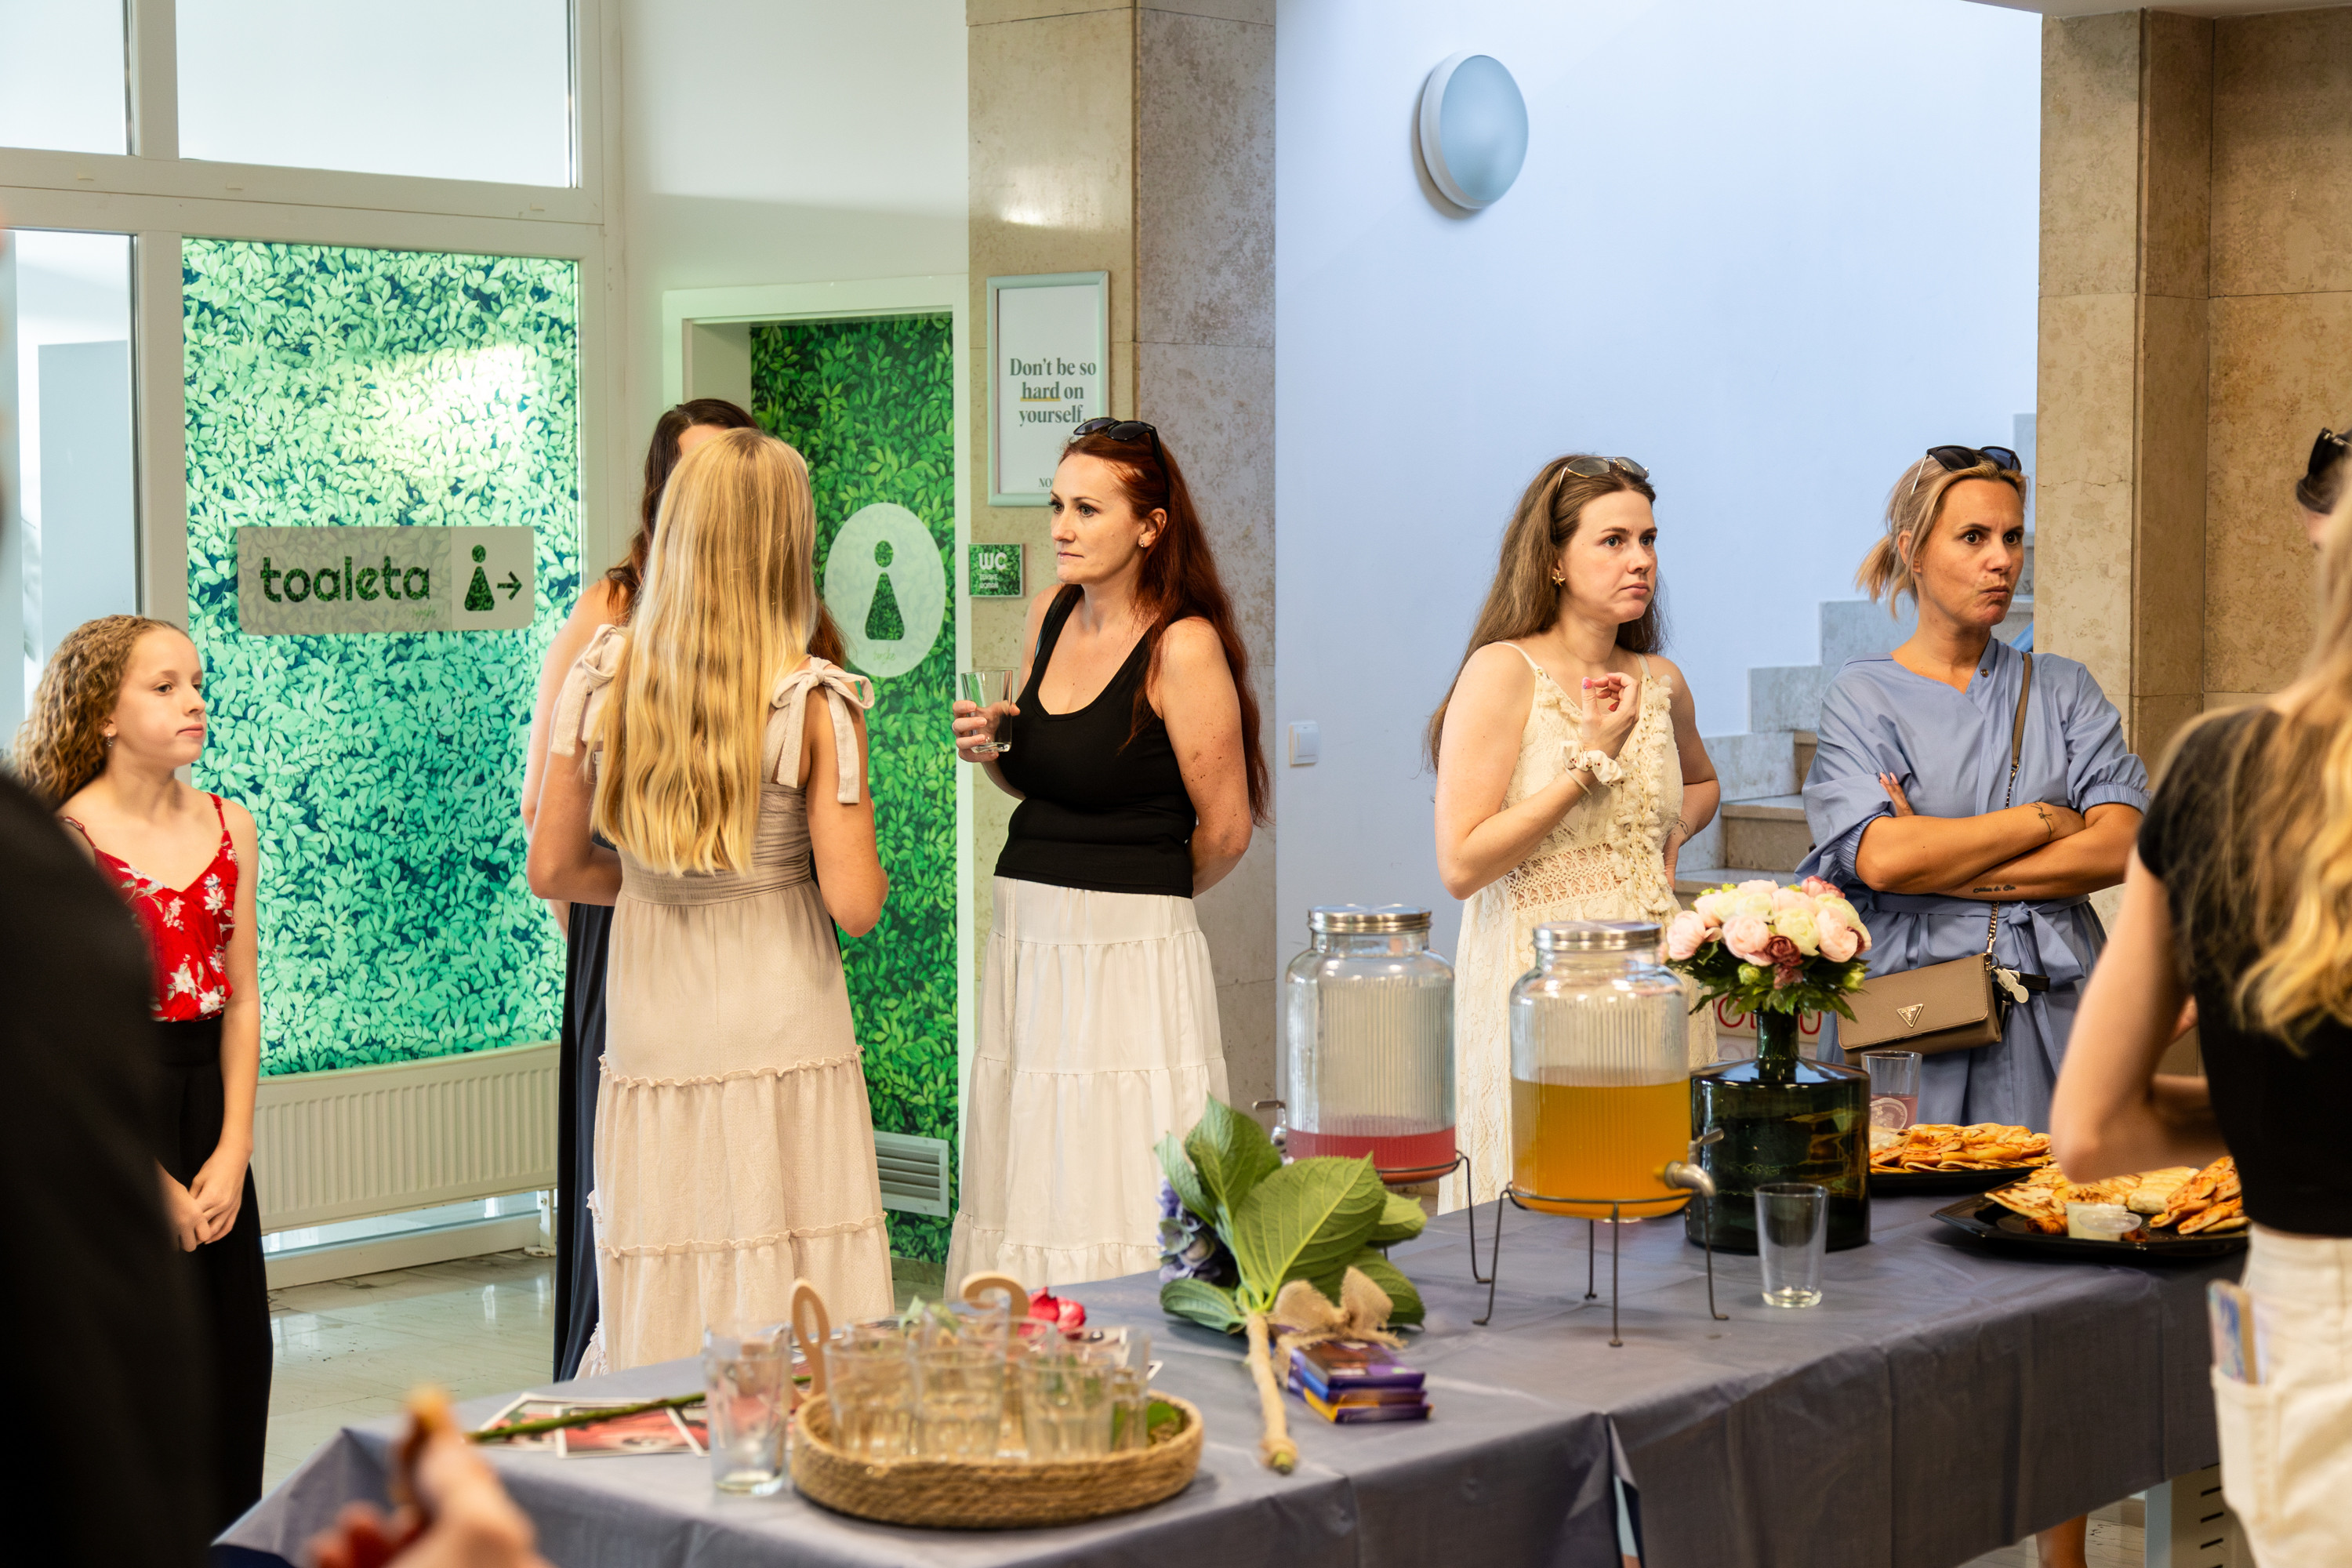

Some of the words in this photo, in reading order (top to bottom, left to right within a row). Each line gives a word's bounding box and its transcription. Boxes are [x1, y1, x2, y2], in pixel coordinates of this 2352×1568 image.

[1009, 358, 1053, 376] Don't
[1056, 357, 1076, 376] be
[1079, 361, 1097, 376] so
[1022, 381, 1060, 399] hard
[1064, 386, 1084, 399] on
[1018, 404, 1087, 426] yourself.
[978, 552, 1007, 570] WC
[260, 555, 430, 603] toaleta
